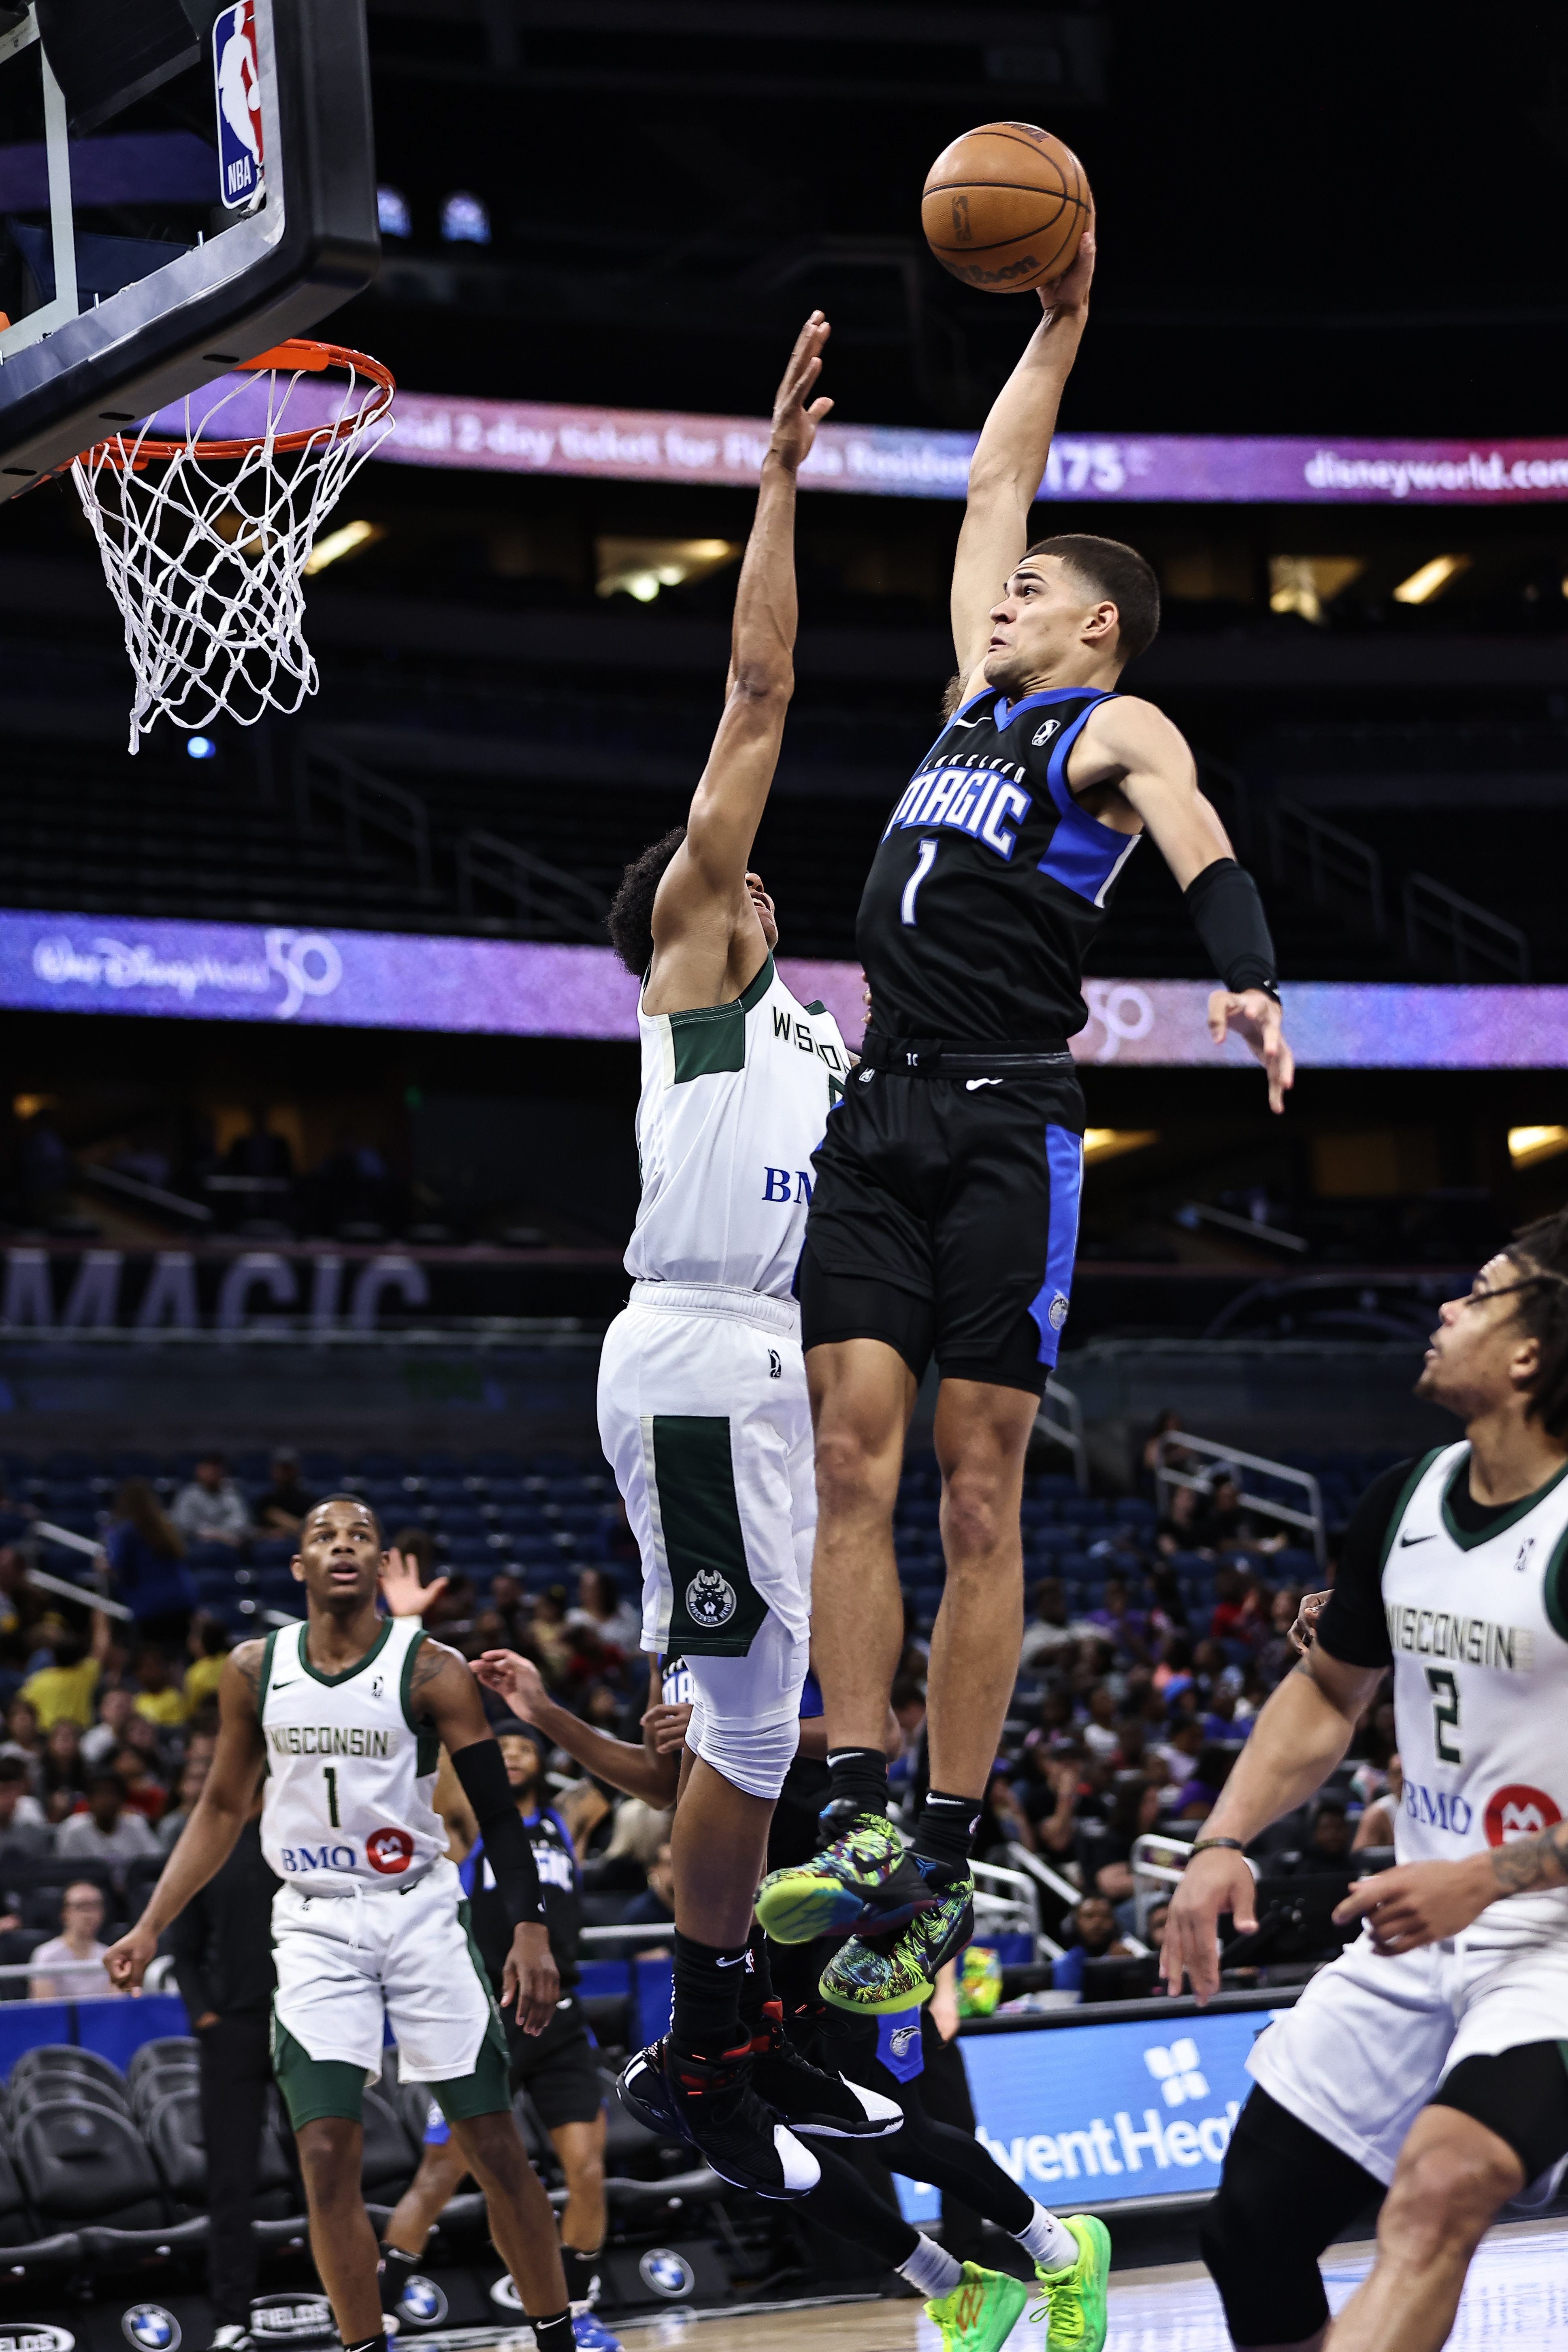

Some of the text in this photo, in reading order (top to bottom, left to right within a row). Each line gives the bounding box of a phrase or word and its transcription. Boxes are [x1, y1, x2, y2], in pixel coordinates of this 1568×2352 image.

[228, 154, 252, 196] NBA
[723, 432, 844, 476] Floda
[881, 767, 1033, 862] MAGIC
[900, 837, 939, 927] 1
[761, 1166, 812, 1208] BM
[1, 1247, 431, 1329] MAGIC
[1425, 1665, 1461, 1765] 2
[324, 1766, 341, 1828] 1
[1403, 1780, 1472, 1835] BMO
[281, 1845, 356, 1872] BMO
[974, 2100, 1242, 2185] ventHea
